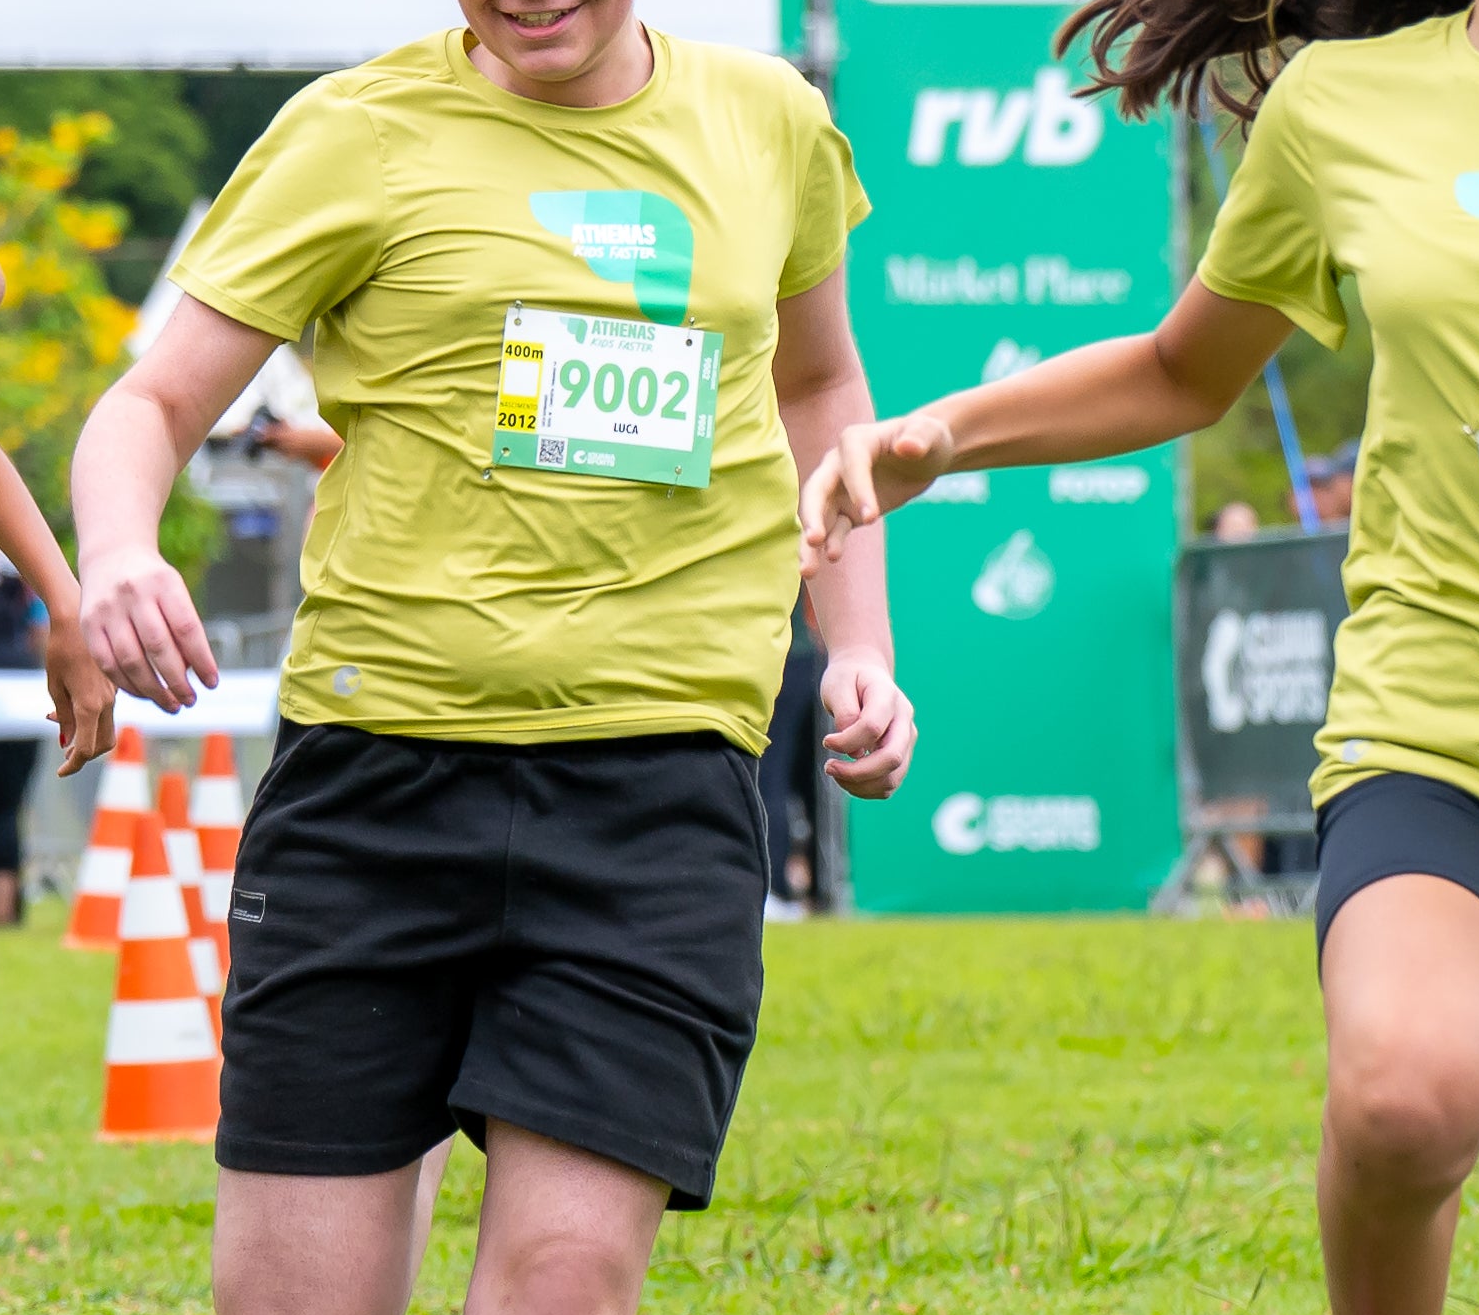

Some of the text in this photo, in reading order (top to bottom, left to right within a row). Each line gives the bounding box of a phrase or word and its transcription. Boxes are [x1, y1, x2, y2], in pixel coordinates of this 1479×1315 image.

[907, 67, 1104, 167] rvb
[571, 223, 657, 246] ATHENAS
[573, 244, 657, 260] KIDS FASTER
[592, 319, 656, 341] ATHENAS
[505, 344, 544, 359] 400m
[590, 338, 654, 352] KIDS FASTER
[559, 359, 690, 421] 9002
[498, 412, 537, 429] 2012
[613, 422, 639, 434] LUCA
